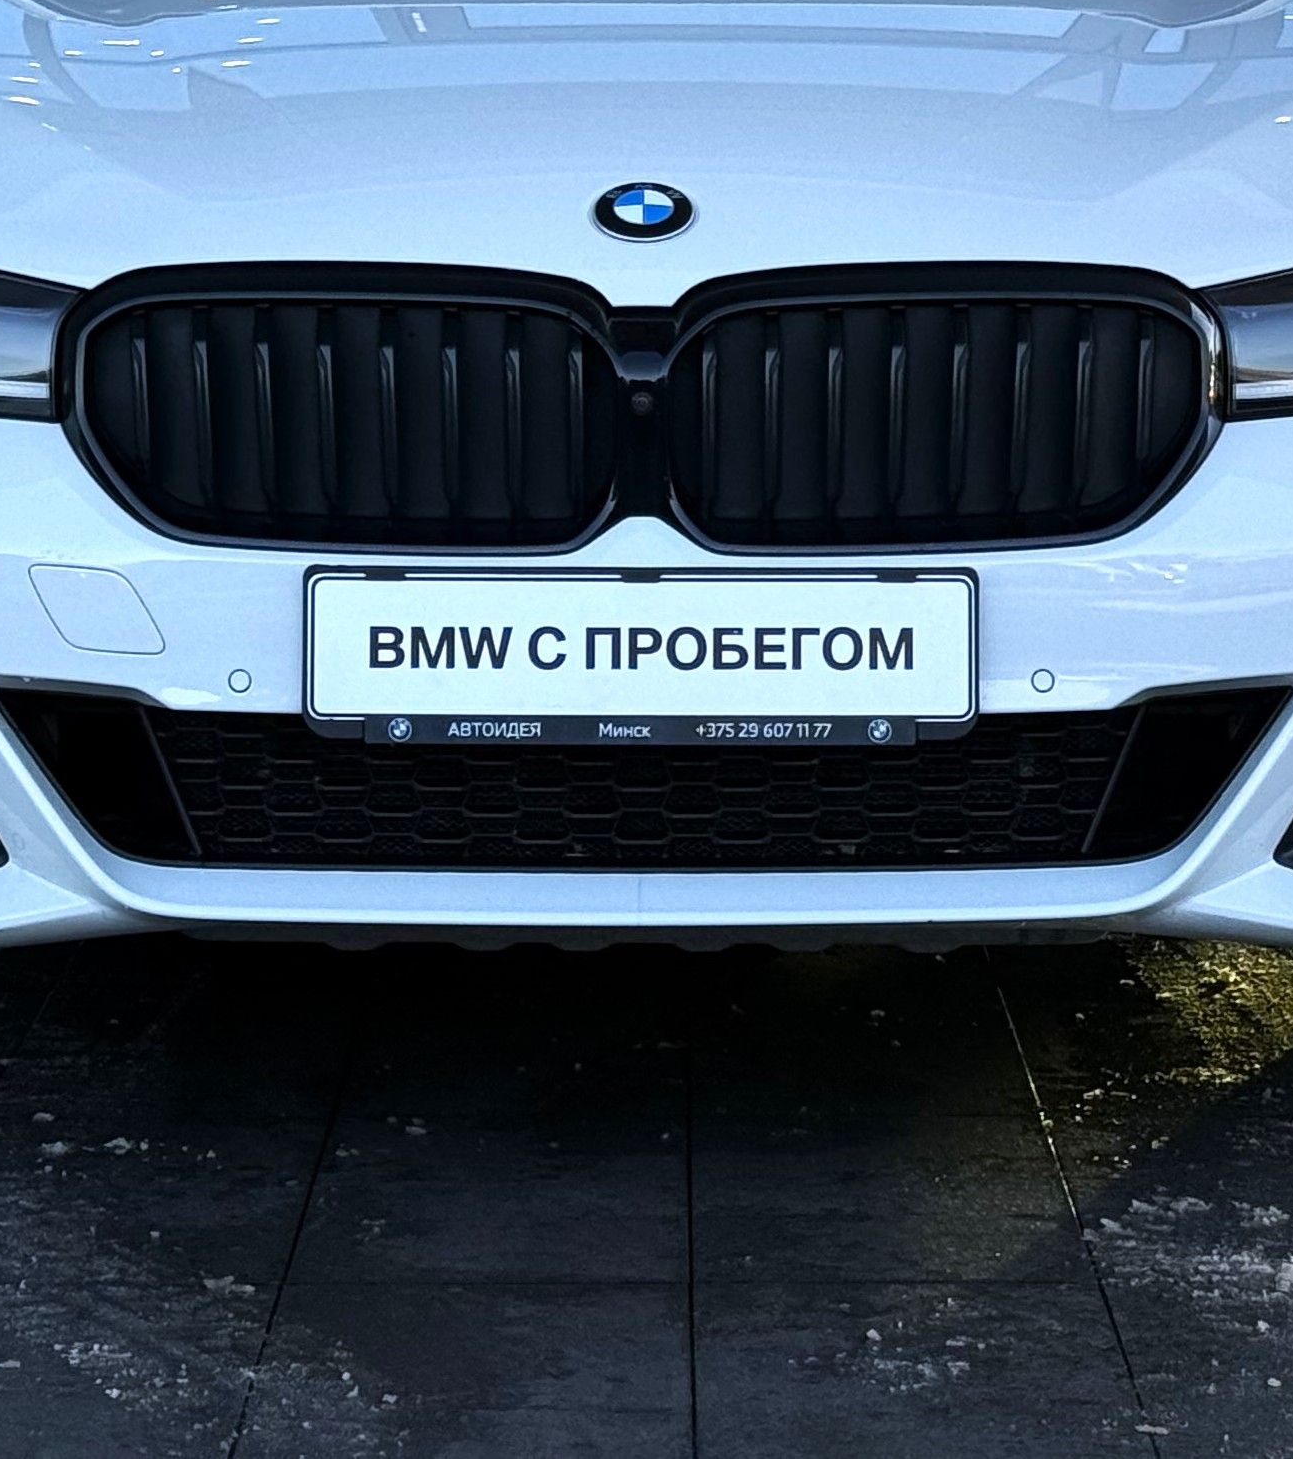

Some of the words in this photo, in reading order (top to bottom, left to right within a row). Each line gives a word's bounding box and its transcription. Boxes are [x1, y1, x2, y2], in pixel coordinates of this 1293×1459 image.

[368, 625, 514, 670] BMW
[527, 625, 567, 671] С
[585, 625, 914, 671] ПРОБЕГОМ
[447, 721, 542, 740] АВТОИДЕЯ
[598, 722, 651, 738] Минск
[695, 722, 735, 738] +375
[738, 722, 759, 738] 29
[763, 722, 794, 738] 607
[796, 722, 810, 738] 11
[813, 722, 833, 738] 77
